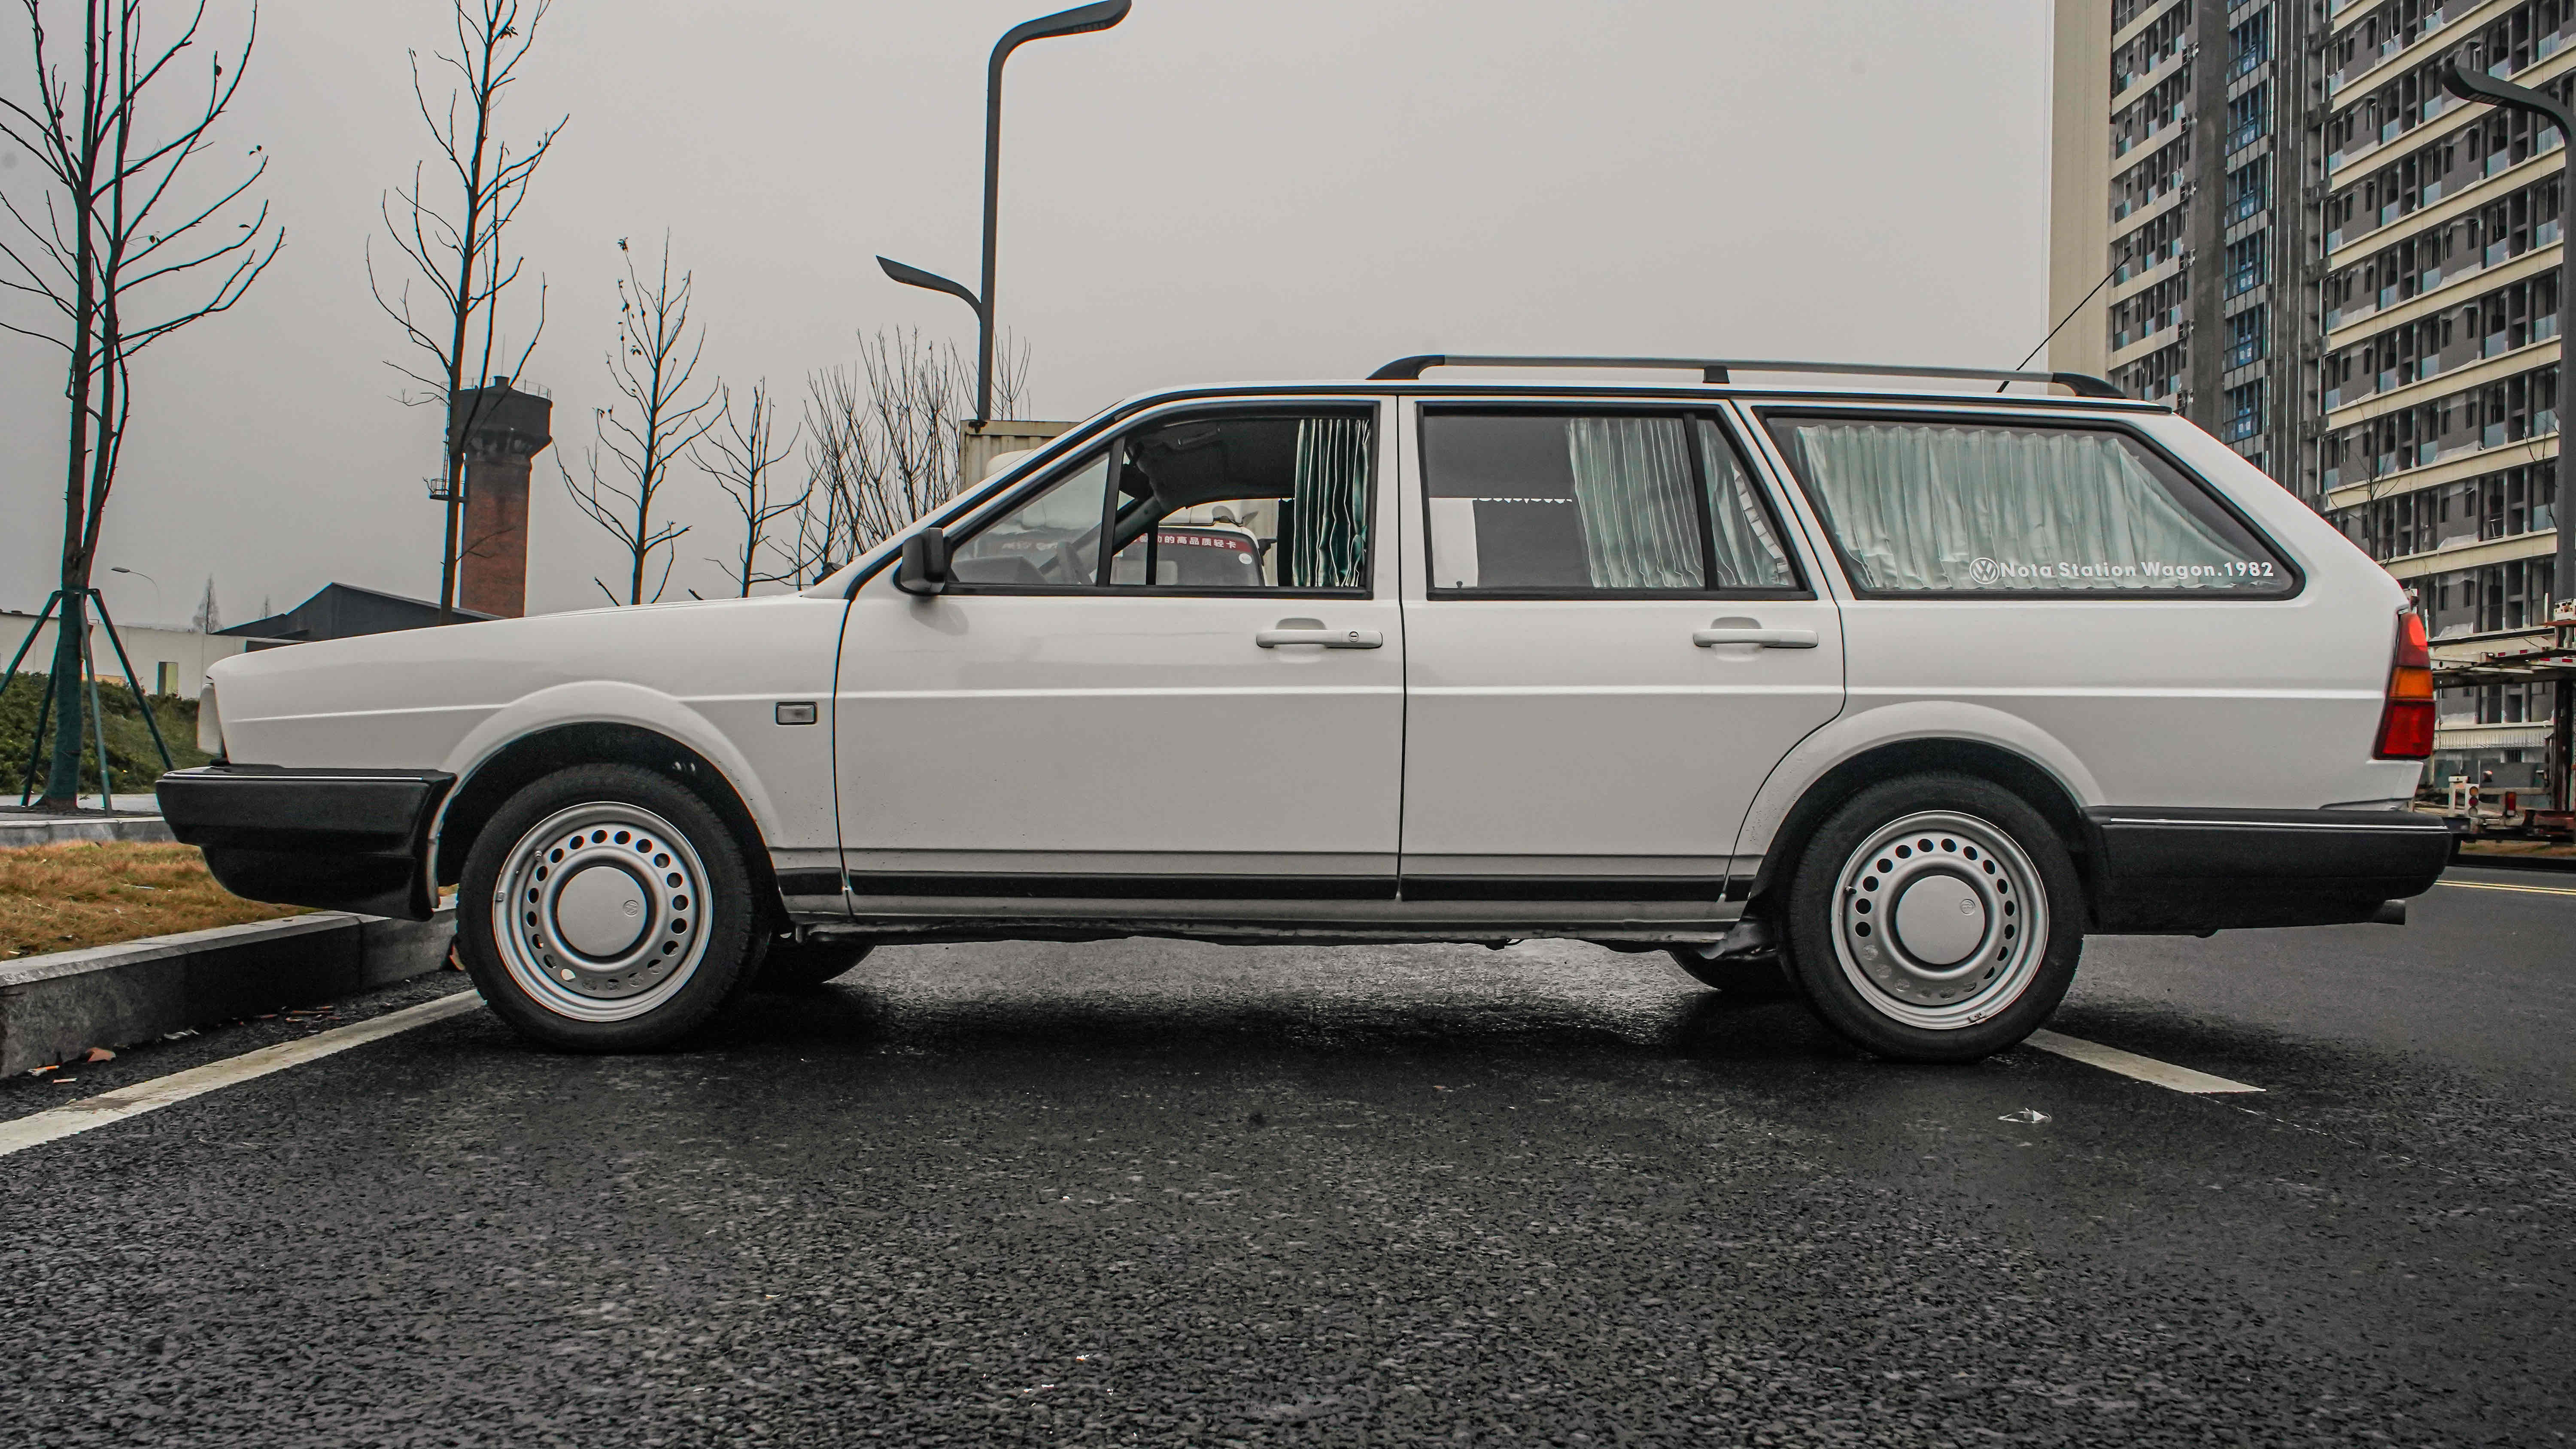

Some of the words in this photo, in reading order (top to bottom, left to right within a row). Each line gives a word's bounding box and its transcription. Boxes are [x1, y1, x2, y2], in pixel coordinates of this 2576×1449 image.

[2000, 562, 2052, 577] Nota
[2058, 562, 2137, 577] Station
[2140, 561, 2274, 580] Wagon.1982
